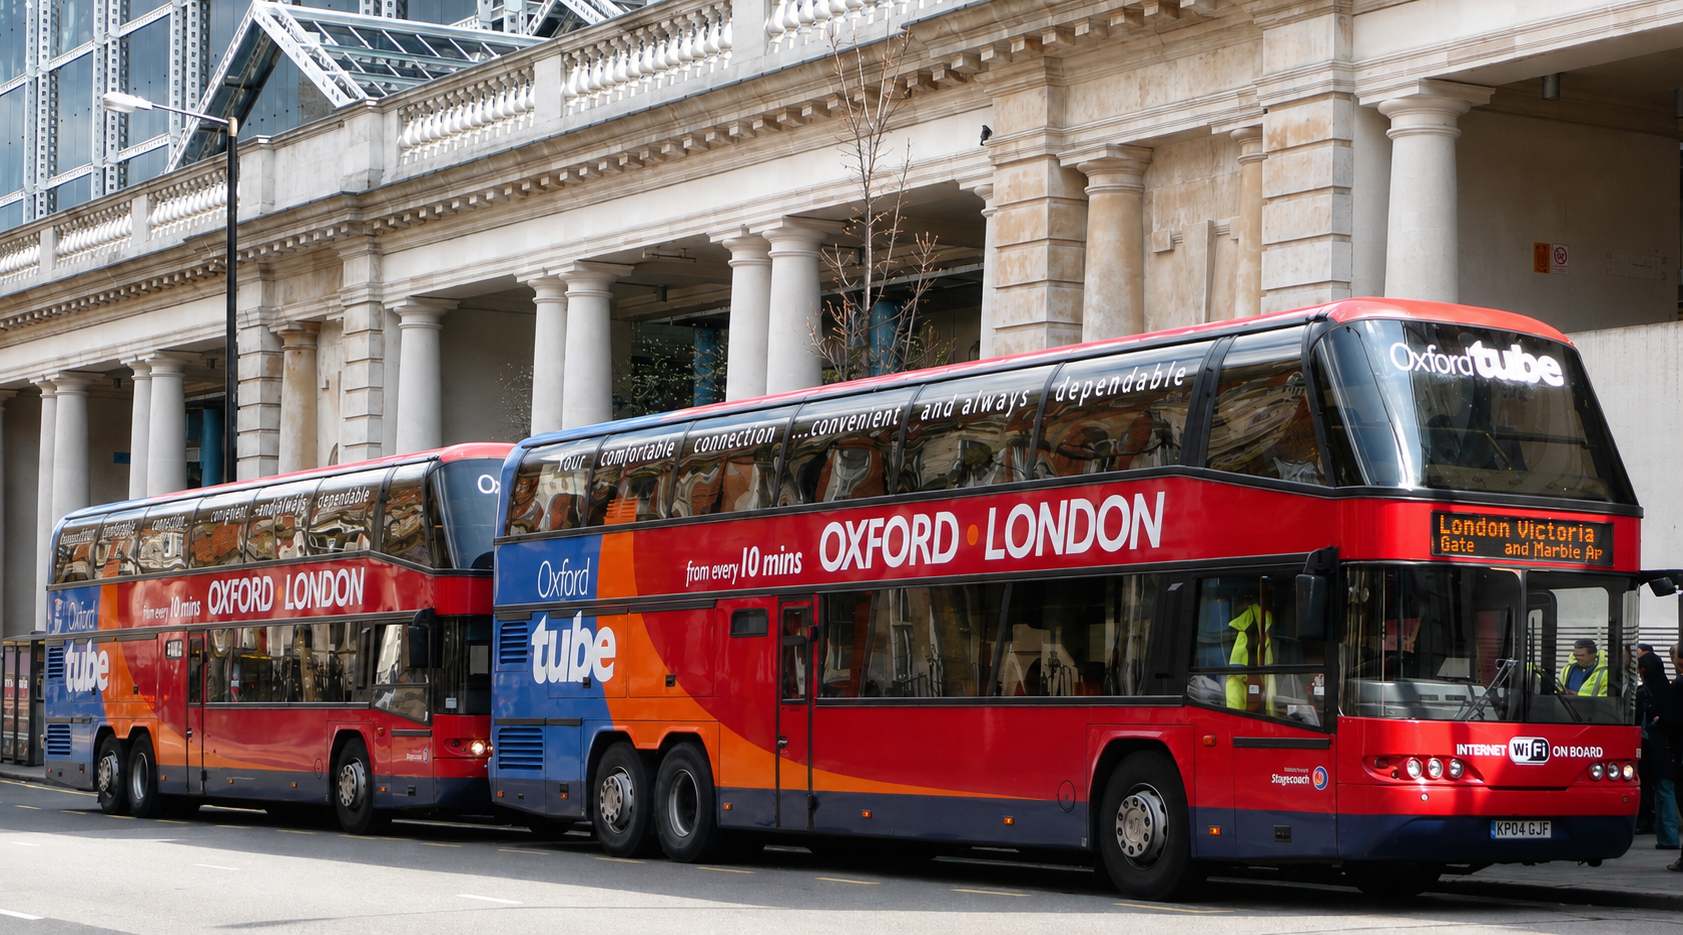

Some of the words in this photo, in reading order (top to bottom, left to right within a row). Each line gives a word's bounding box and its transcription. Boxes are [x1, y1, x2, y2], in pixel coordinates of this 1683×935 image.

[1389, 342, 1475, 376] Oxford
[1469, 340, 1564, 387] tube
[557, 451, 586, 473] Your
[600, 437, 675, 467] comfortable
[693, 425, 776, 454] connection
[920, 394, 954, 421] and
[961, 389, 1030, 418] always
[1055, 360, 1187, 407] dependable
[318, 486, 370, 512] dependable
[818, 511, 960, 573] OXFORD
[985, 491, 1165, 561] LONDON
[1439, 515, 1511, 538] London
[1517, 520, 1595, 543] Victoria
[1441, 536, 1475, 553] Gate
[1504, 542, 1529, 556] and
[537, 557, 590, 598] Oxford
[685, 560, 709, 587] from
[711, 563, 739, 586] every
[741, 545, 760, 578] 10
[762, 540, 803, 576] mins
[170, 596, 180, 618] 10
[180, 595, 201, 618] mins
[207, 575, 274, 616] OXFORD
[284, 567, 365, 611] LONDON
[65, 639, 109, 693] tube
[531, 610, 616, 684] tube
[1456, 743, 1508, 757] INTERNET
[1512, 742, 1547, 758] WiFi
[1552, 746, 1568, 758] ON
[1570, 746, 1604, 758] BOARD
[1271, 773, 1310, 786] Stagecoach
[1497, 821, 1526, 836] KP04
[1528, 821, 1550, 836] GJF
